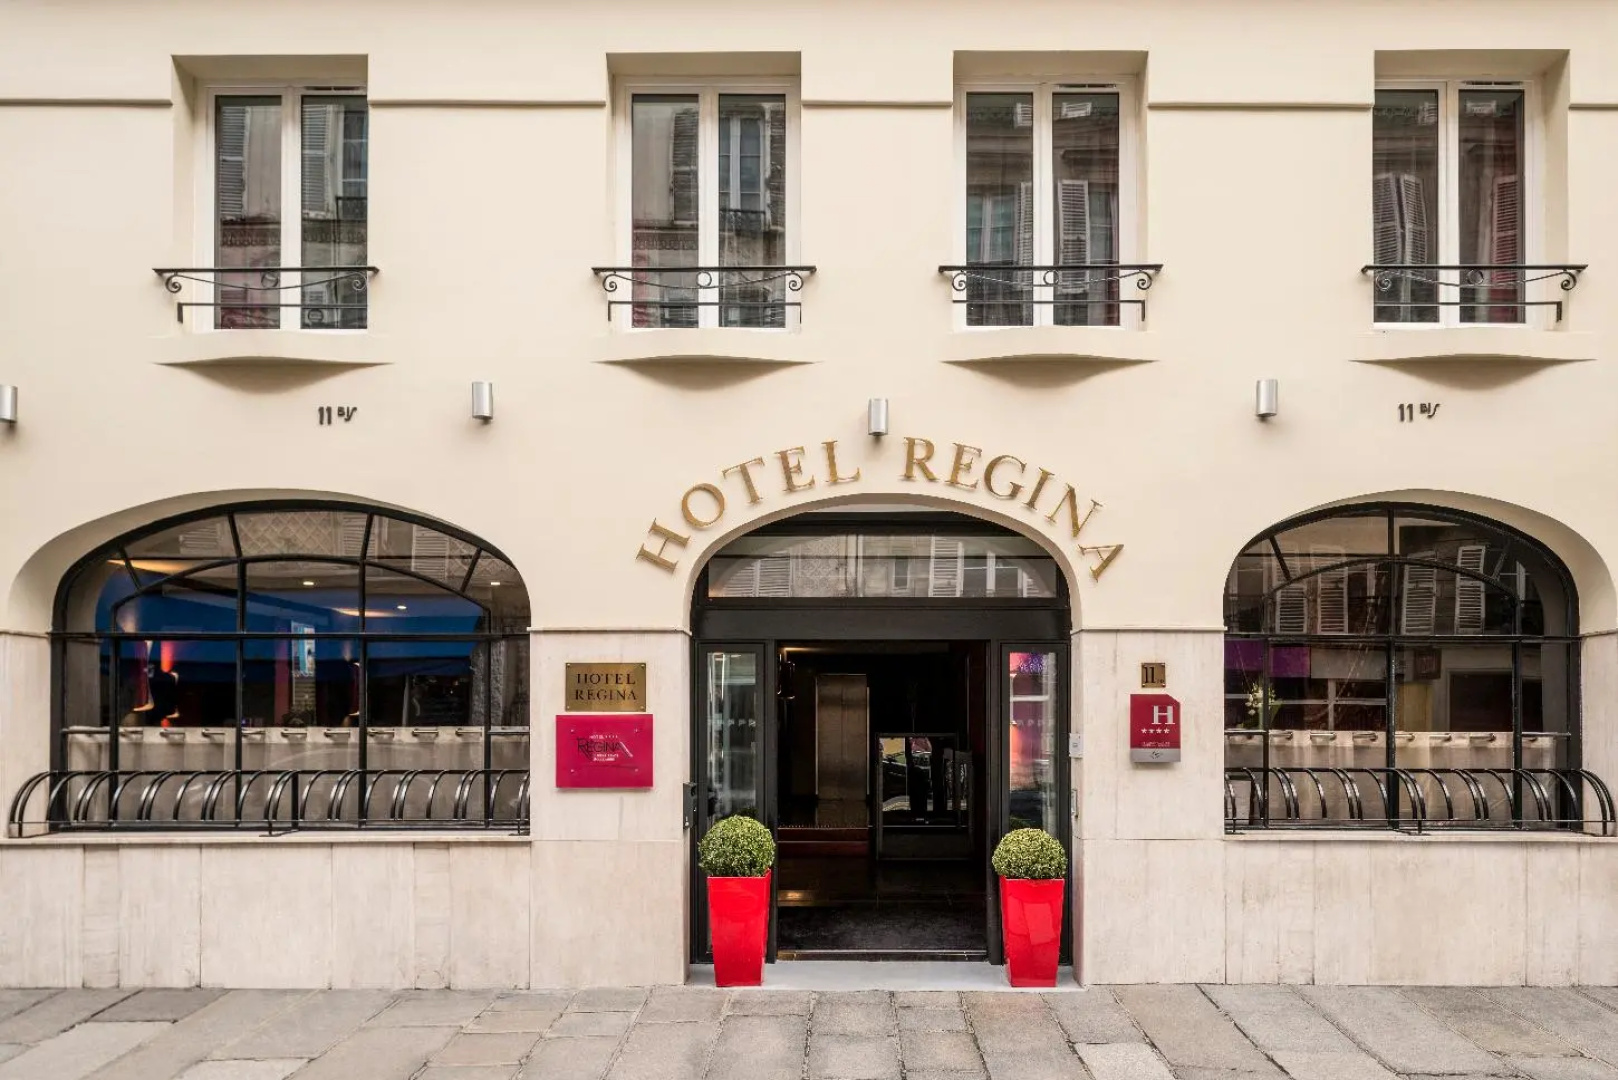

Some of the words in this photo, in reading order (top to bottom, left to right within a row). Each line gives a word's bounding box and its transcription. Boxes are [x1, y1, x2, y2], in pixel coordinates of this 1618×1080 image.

[318, 406, 332, 426] 11
[1398, 403, 1414, 422] 11
[635, 440, 861, 574] HOTEL
[900, 436, 1124, 583] REGINA
[576, 673, 636, 685] HOTEL
[575, 688, 637, 701] REGINA
[1152, 705, 1176, 725] H
[577, 738, 633, 760] REGINA
